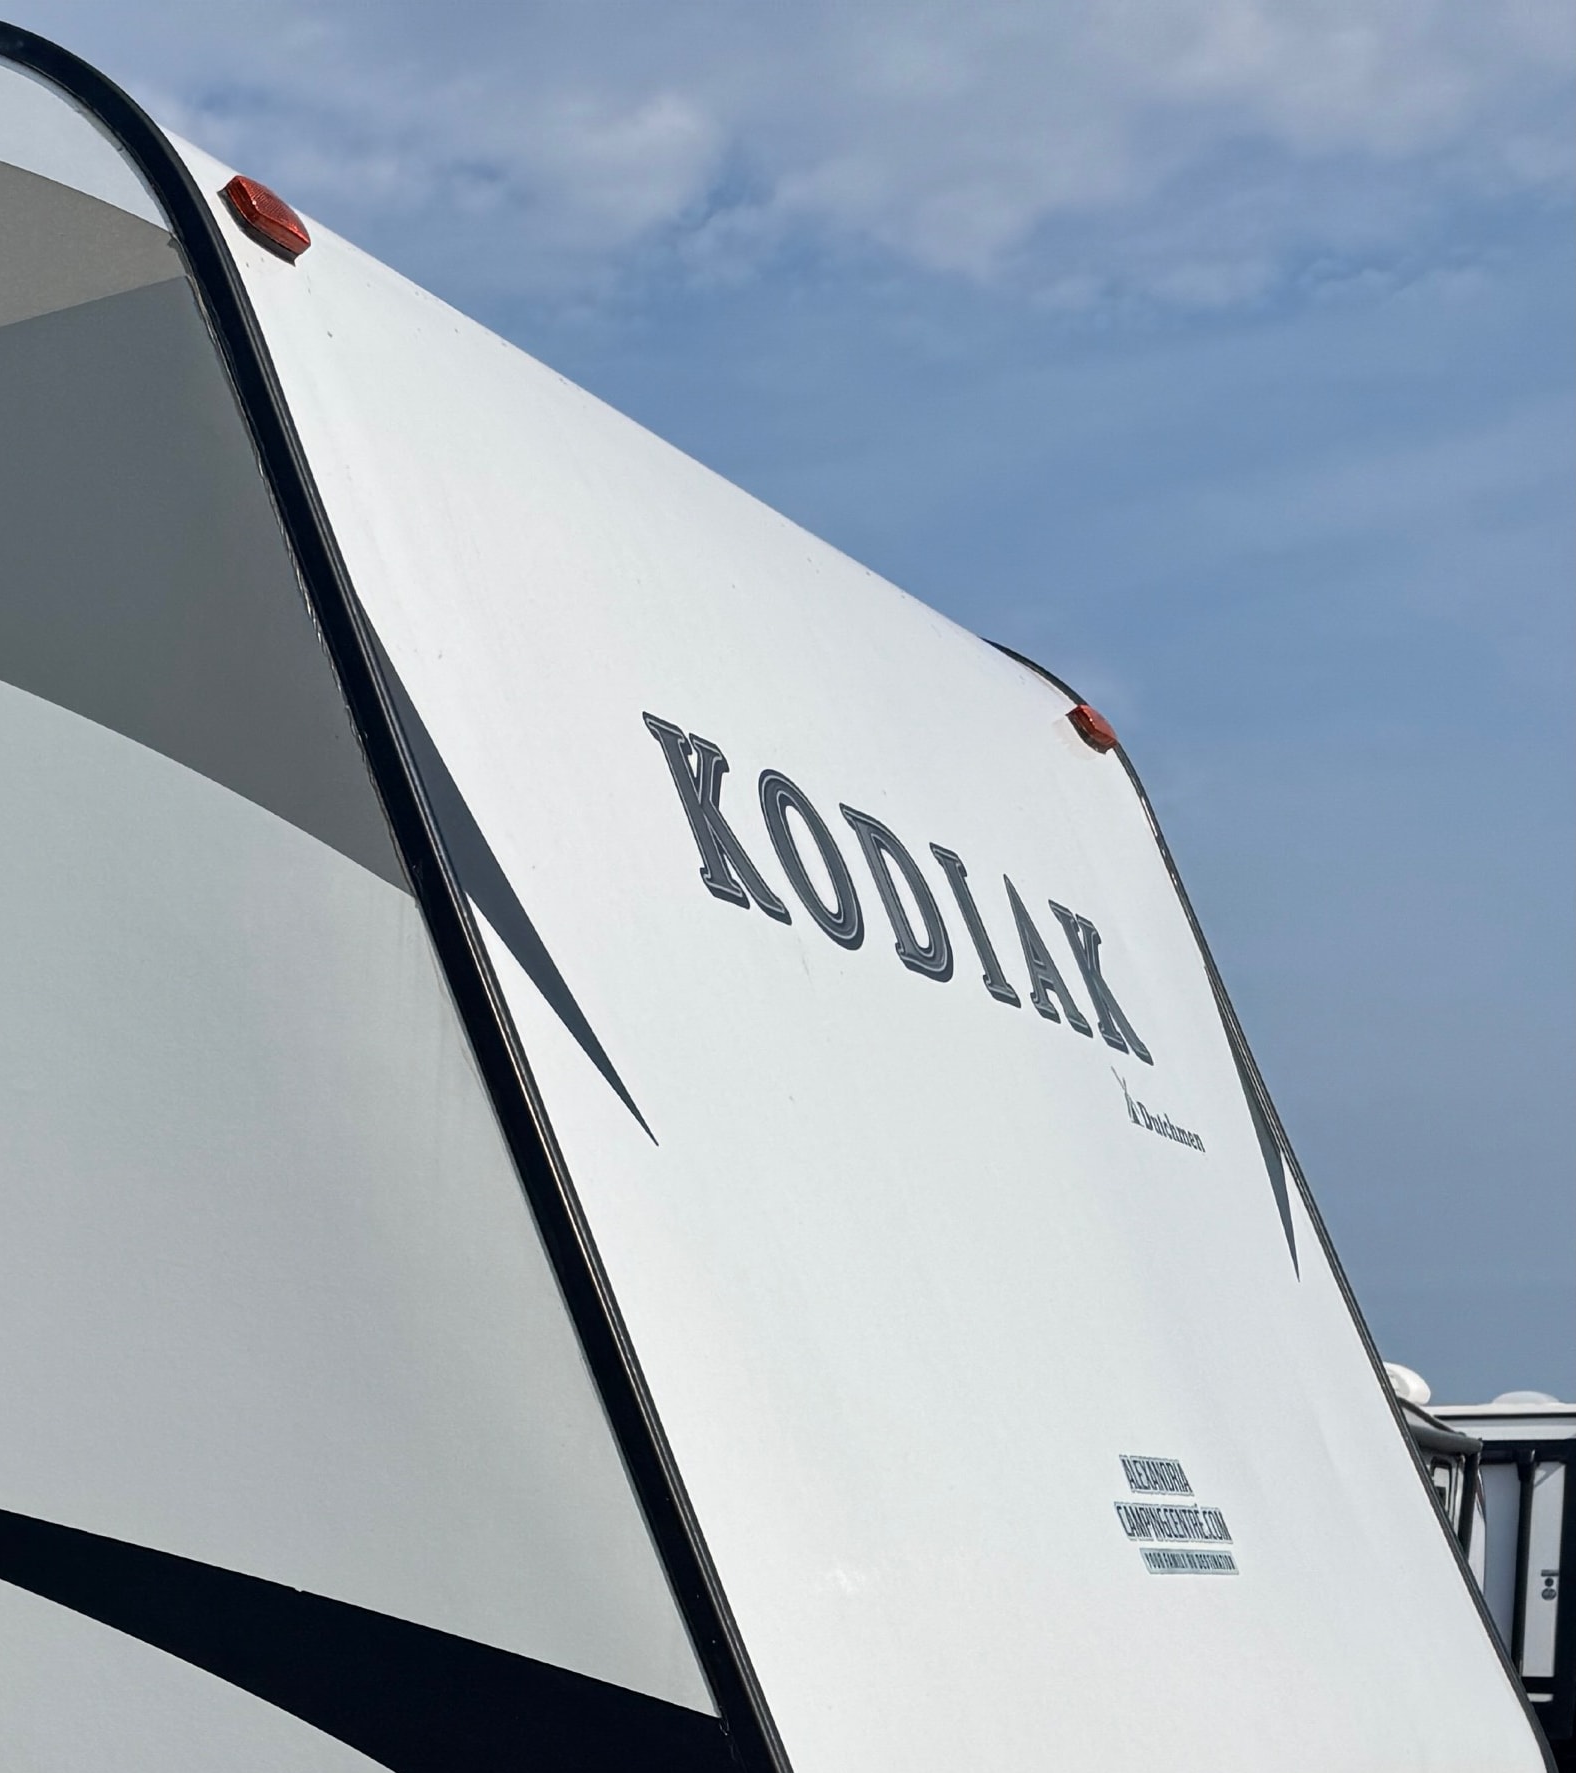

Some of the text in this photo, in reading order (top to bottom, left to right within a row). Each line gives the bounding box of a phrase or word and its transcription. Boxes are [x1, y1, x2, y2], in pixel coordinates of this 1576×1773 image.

[642, 711, 1154, 1066] KODIAK
[1136, 1101, 1206, 1153] Dutchmen
[1121, 1458, 1194, 1493] ALEXANDRIA
